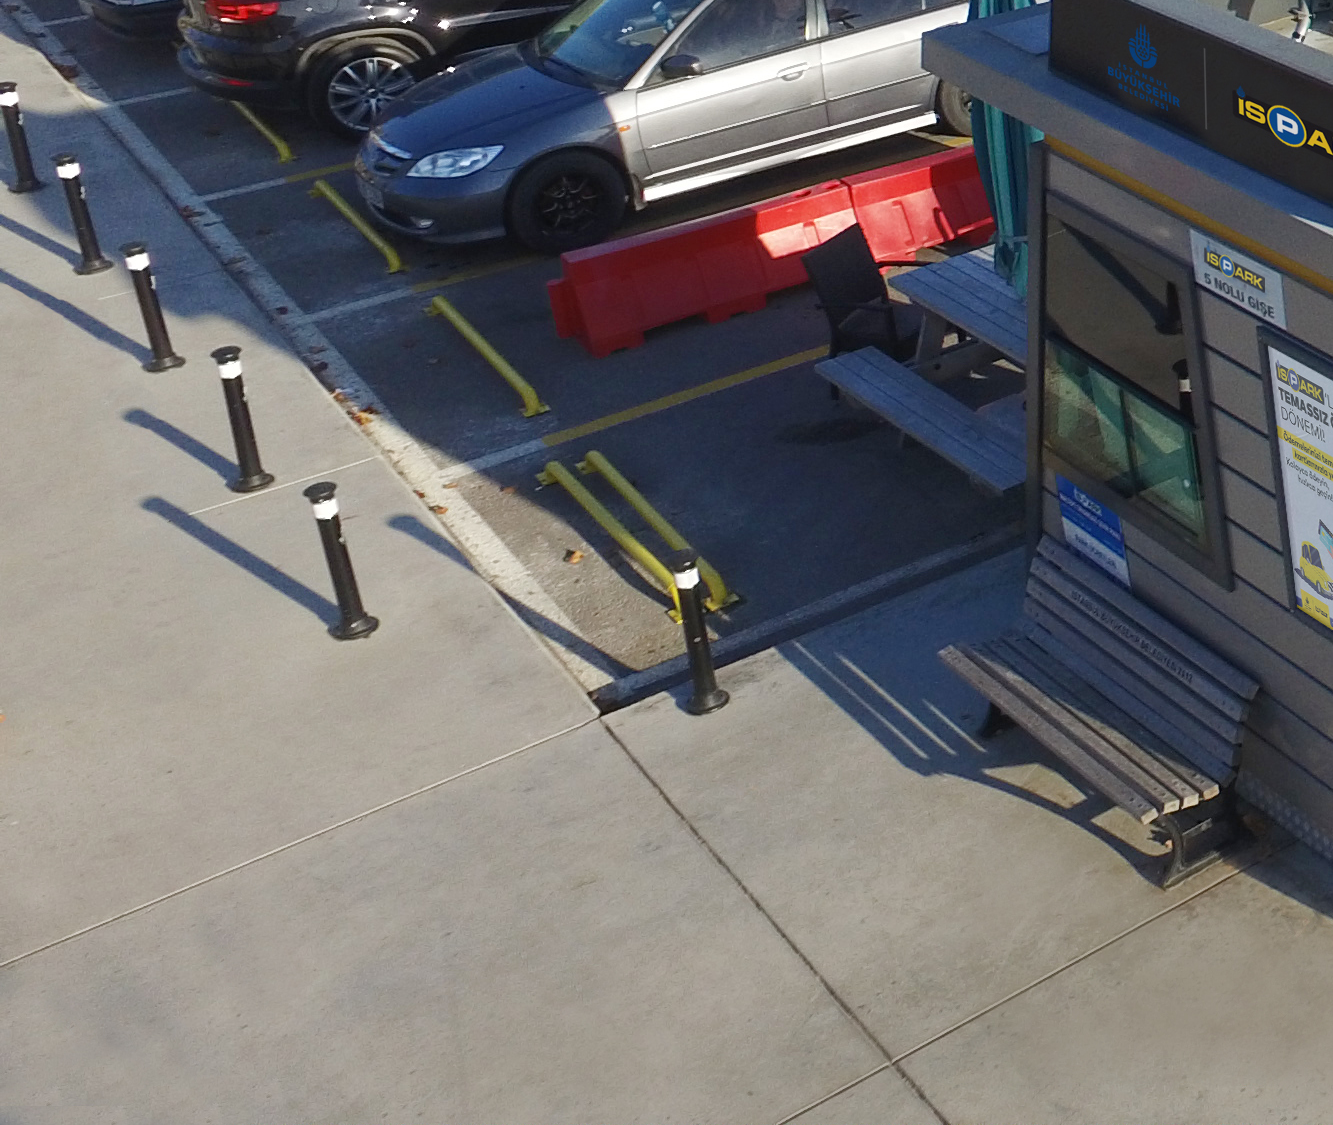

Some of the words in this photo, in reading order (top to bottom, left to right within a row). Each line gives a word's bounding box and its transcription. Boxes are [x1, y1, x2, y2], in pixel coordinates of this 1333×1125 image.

[1107, 65, 1181, 108] BÜYÜKŞEHİR
[1118, 83, 1169, 112] BELEDİYESİ
[1214, 277, 1245, 303] NOLU
[1278, 386, 1330, 427] TEMASSIZ
